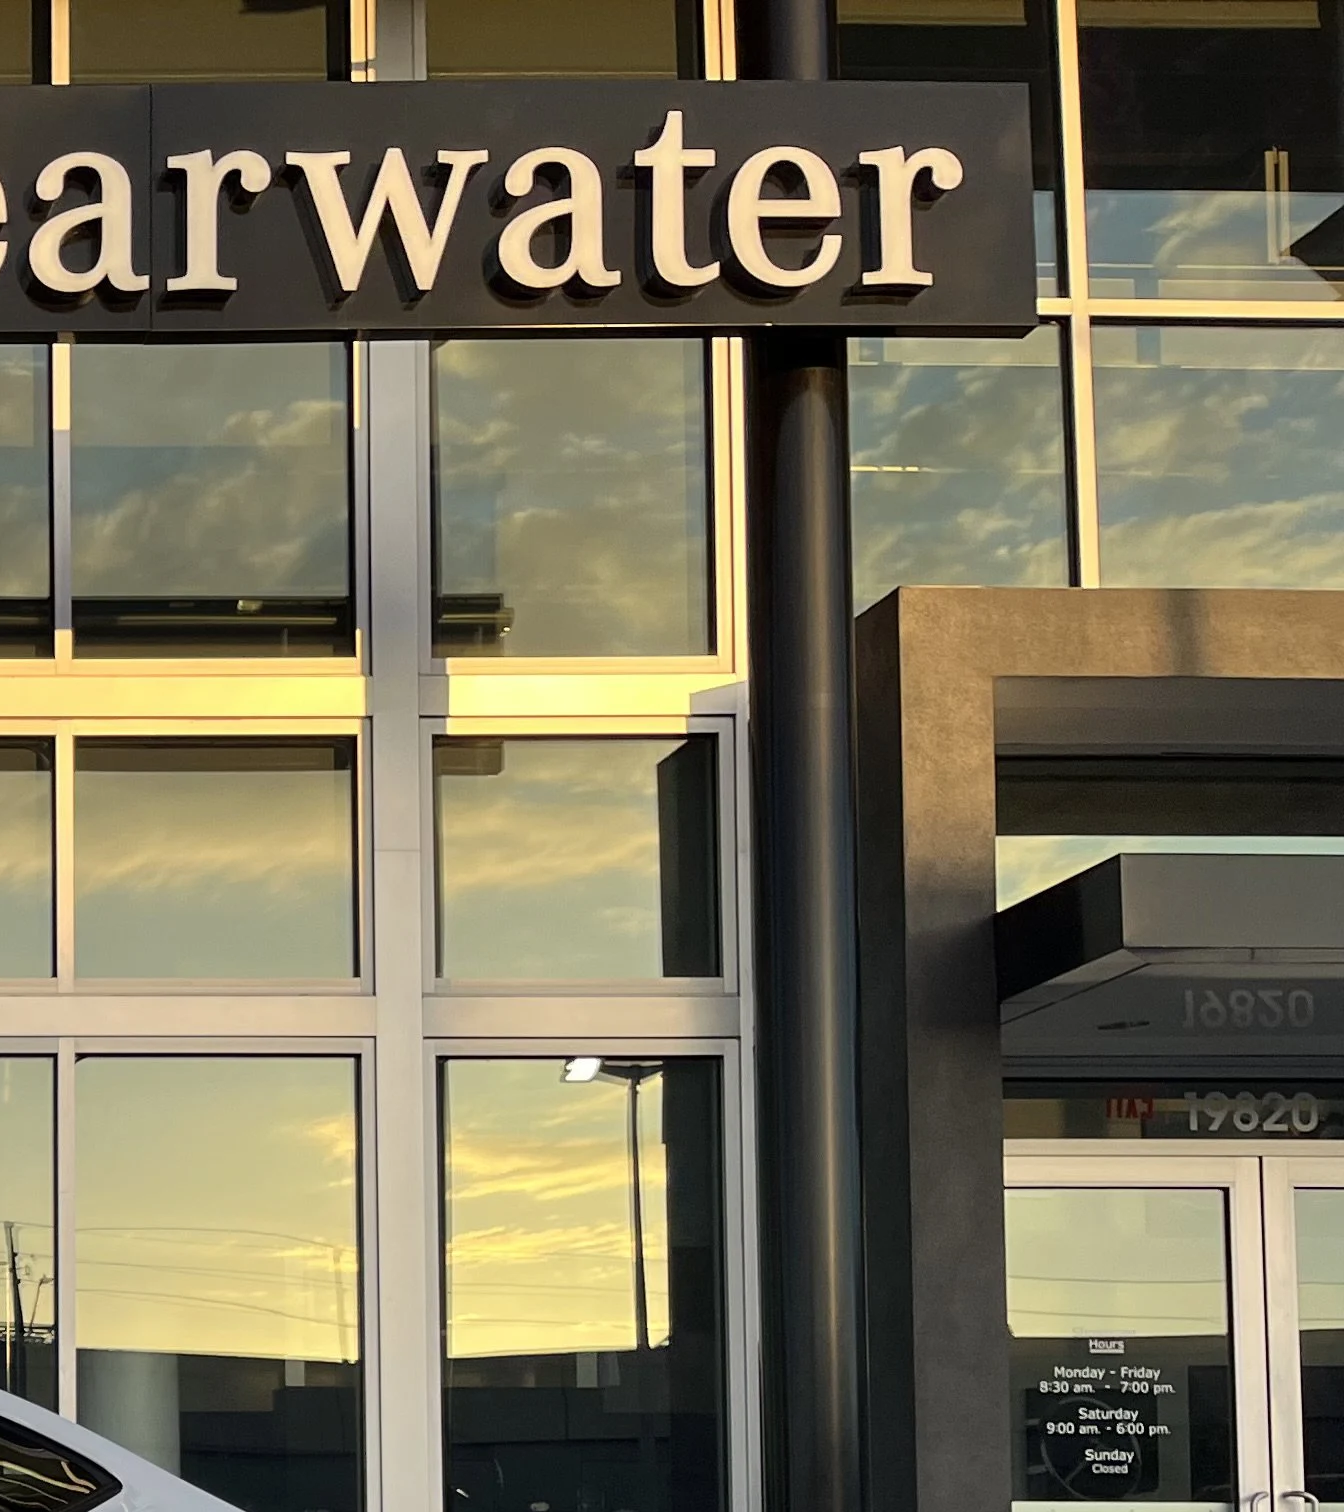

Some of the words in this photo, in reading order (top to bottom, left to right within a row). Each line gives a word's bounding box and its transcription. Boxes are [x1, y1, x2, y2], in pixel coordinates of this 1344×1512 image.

[1183, 1091, 1320, 1132] 19820
[1089, 1339, 1125, 1353] Hours
[1053, 1366, 1106, 1381] Monday
[1120, 1366, 1161, 1380] Friday
[1039, 1381, 1069, 1394] 8:30
[1073, 1383, 1096, 1394] am.
[1120, 1381, 1149, 1394] 7:00
[1153, 1383, 1176, 1396] pm.
[1078, 1407, 1139, 1422] Saturday
[1046, 1422, 1075, 1435] 9:00
[1079, 1425, 1102, 1435] am.
[1116, 1422, 1145, 1435] 6:00
[1149, 1425, 1172, 1437] pm.
[1084, 1448, 1135, 1464] Sunday
[1092, 1463, 1129, 1474] Closed
